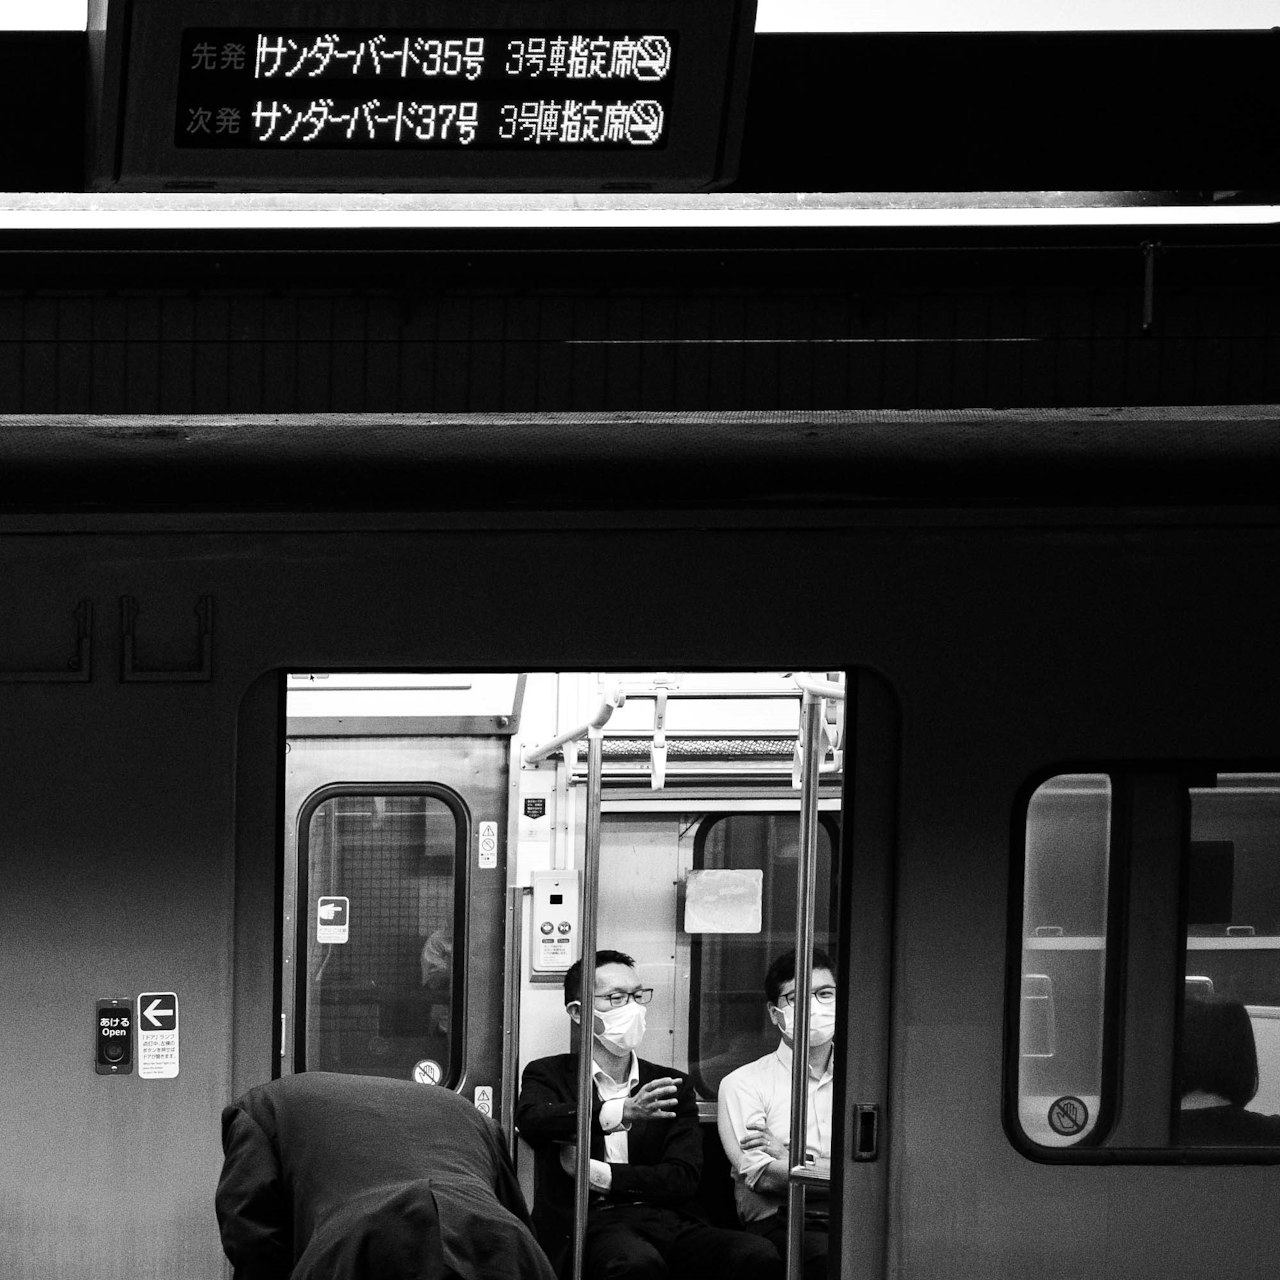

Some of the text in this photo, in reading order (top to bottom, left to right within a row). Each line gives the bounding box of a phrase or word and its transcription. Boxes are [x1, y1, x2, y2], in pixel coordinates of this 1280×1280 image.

[191, 42, 246, 71] 先発
[258, 34, 486, 82] サンダーバード35号
[188, 106, 241, 135] 次発
[252, 99, 479, 144] サンダーバード37号
[99, 1017, 130, 1027] あける
[101, 1028, 127, 1038] Open
